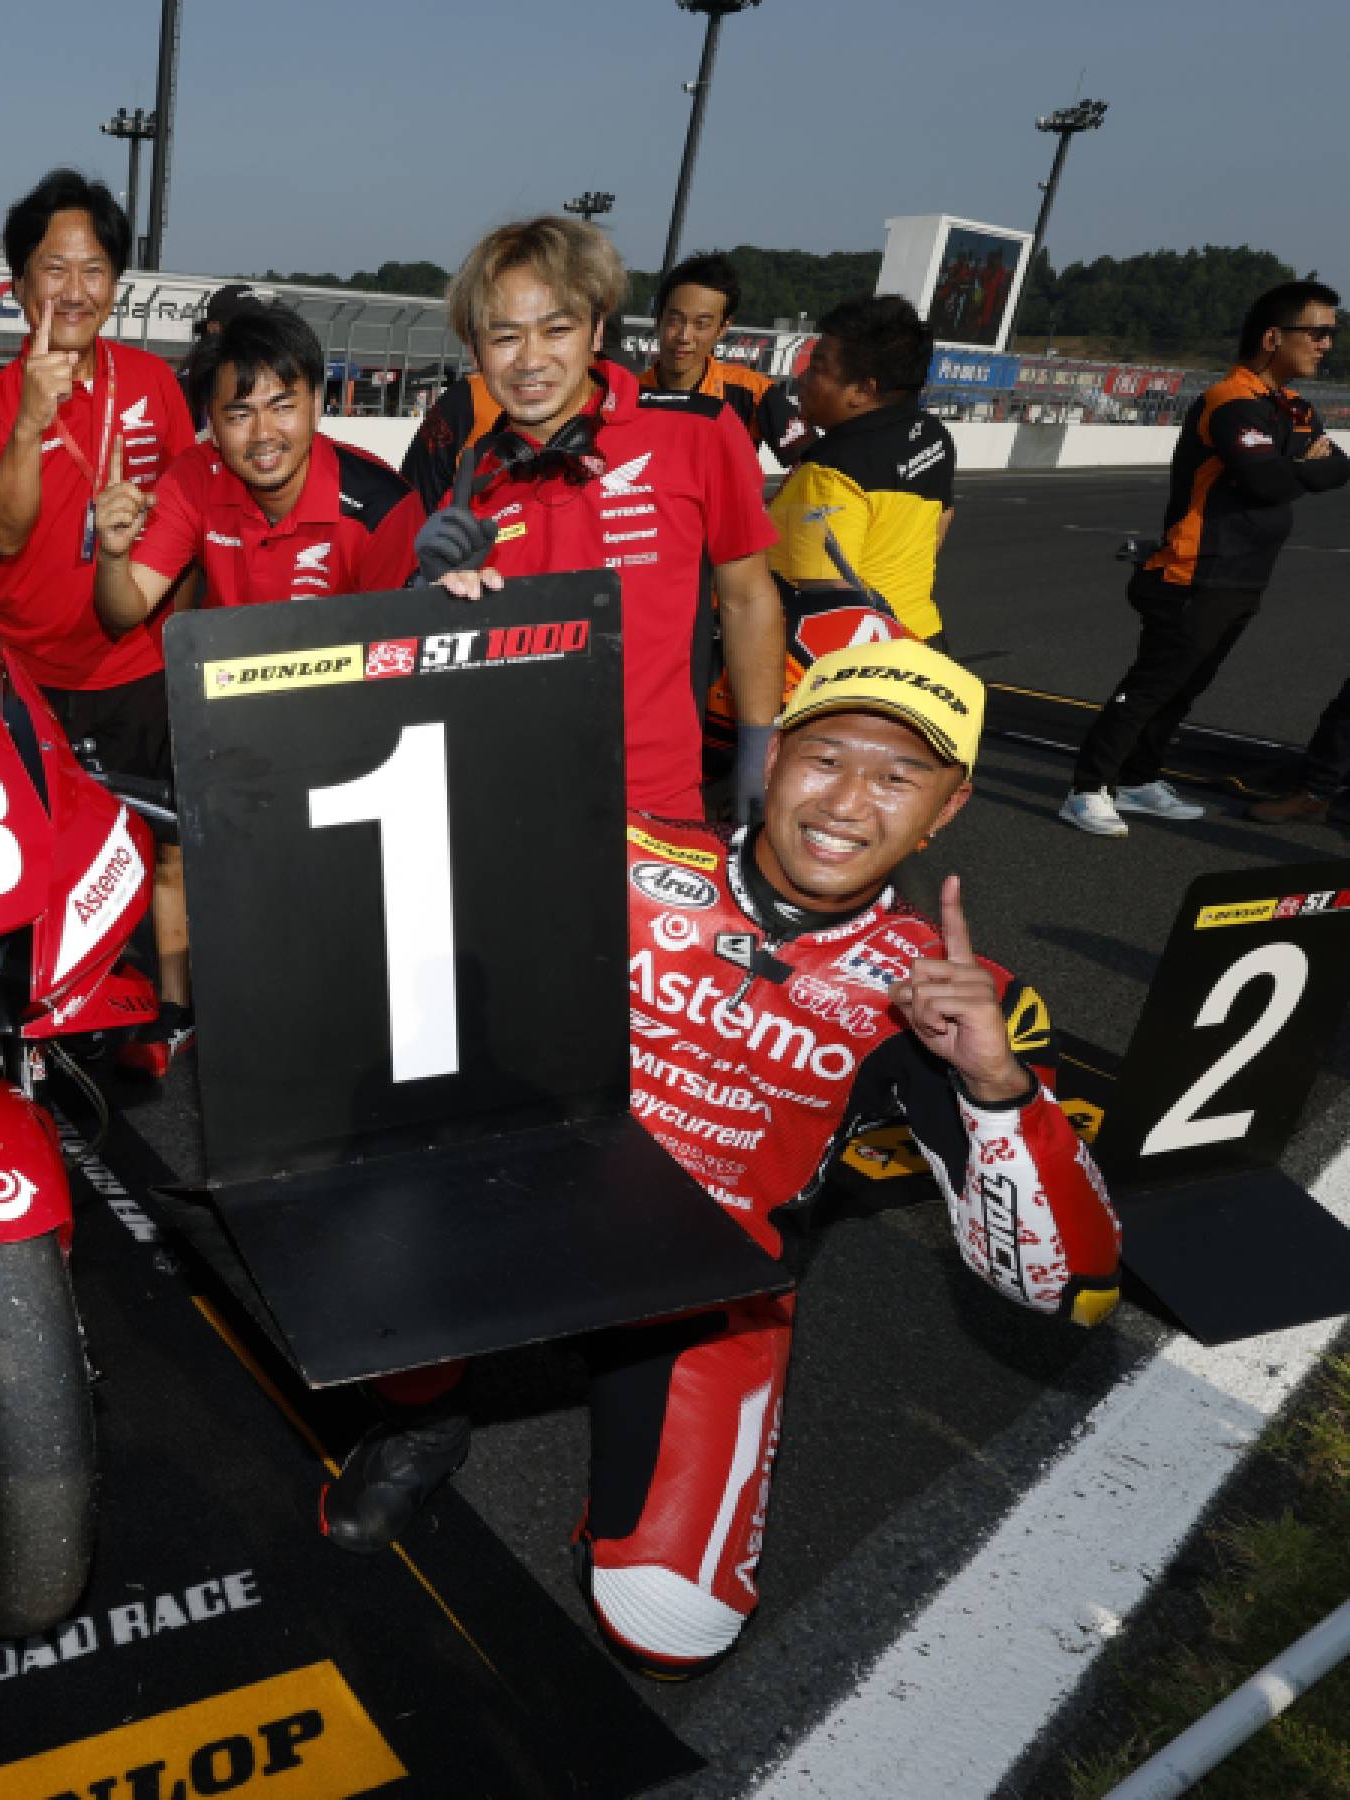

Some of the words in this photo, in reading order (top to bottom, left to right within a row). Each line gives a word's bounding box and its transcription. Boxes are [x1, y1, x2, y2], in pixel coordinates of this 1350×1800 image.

[237, 656, 352, 685] DUNLOP
[421, 630, 480, 667] ST
[486, 620, 591, 659] 1000
[75, 847, 132, 926] Astemo
[308, 721, 459, 1083] 1
[640, 867, 703, 900] Arai
[630, 949, 855, 1081] Astemo
[1139, 942, 1308, 1156] 2
[111, 1570, 262, 1646] RACE
